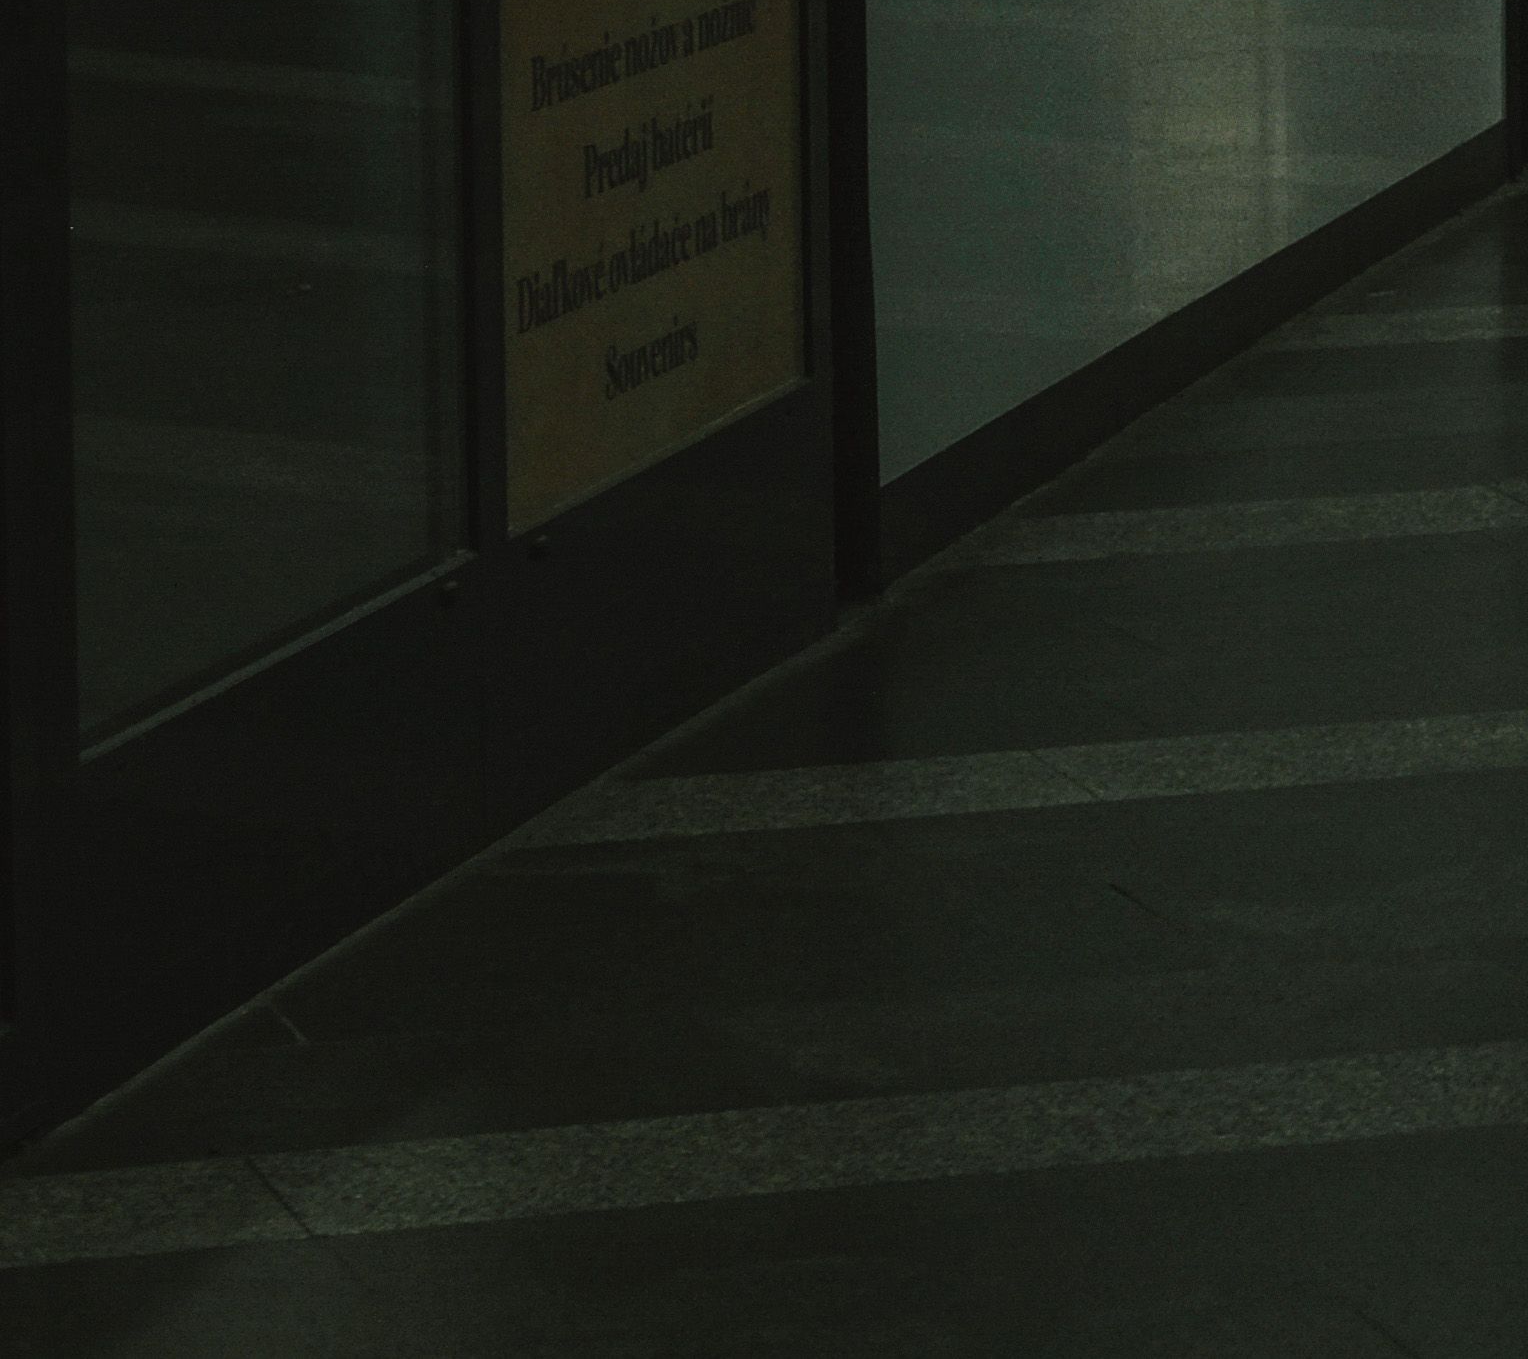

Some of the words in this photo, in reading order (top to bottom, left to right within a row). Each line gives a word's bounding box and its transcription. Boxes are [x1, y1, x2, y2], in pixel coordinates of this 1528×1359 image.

[531, 31, 622, 112] Brúsenie
[624, 16, 677, 78] nožov
[682, 19, 694, 57] a
[583, 122, 649, 198] Predaj
[695, 212, 718, 253] na
[604, 315, 699, 401] Souvenirs
